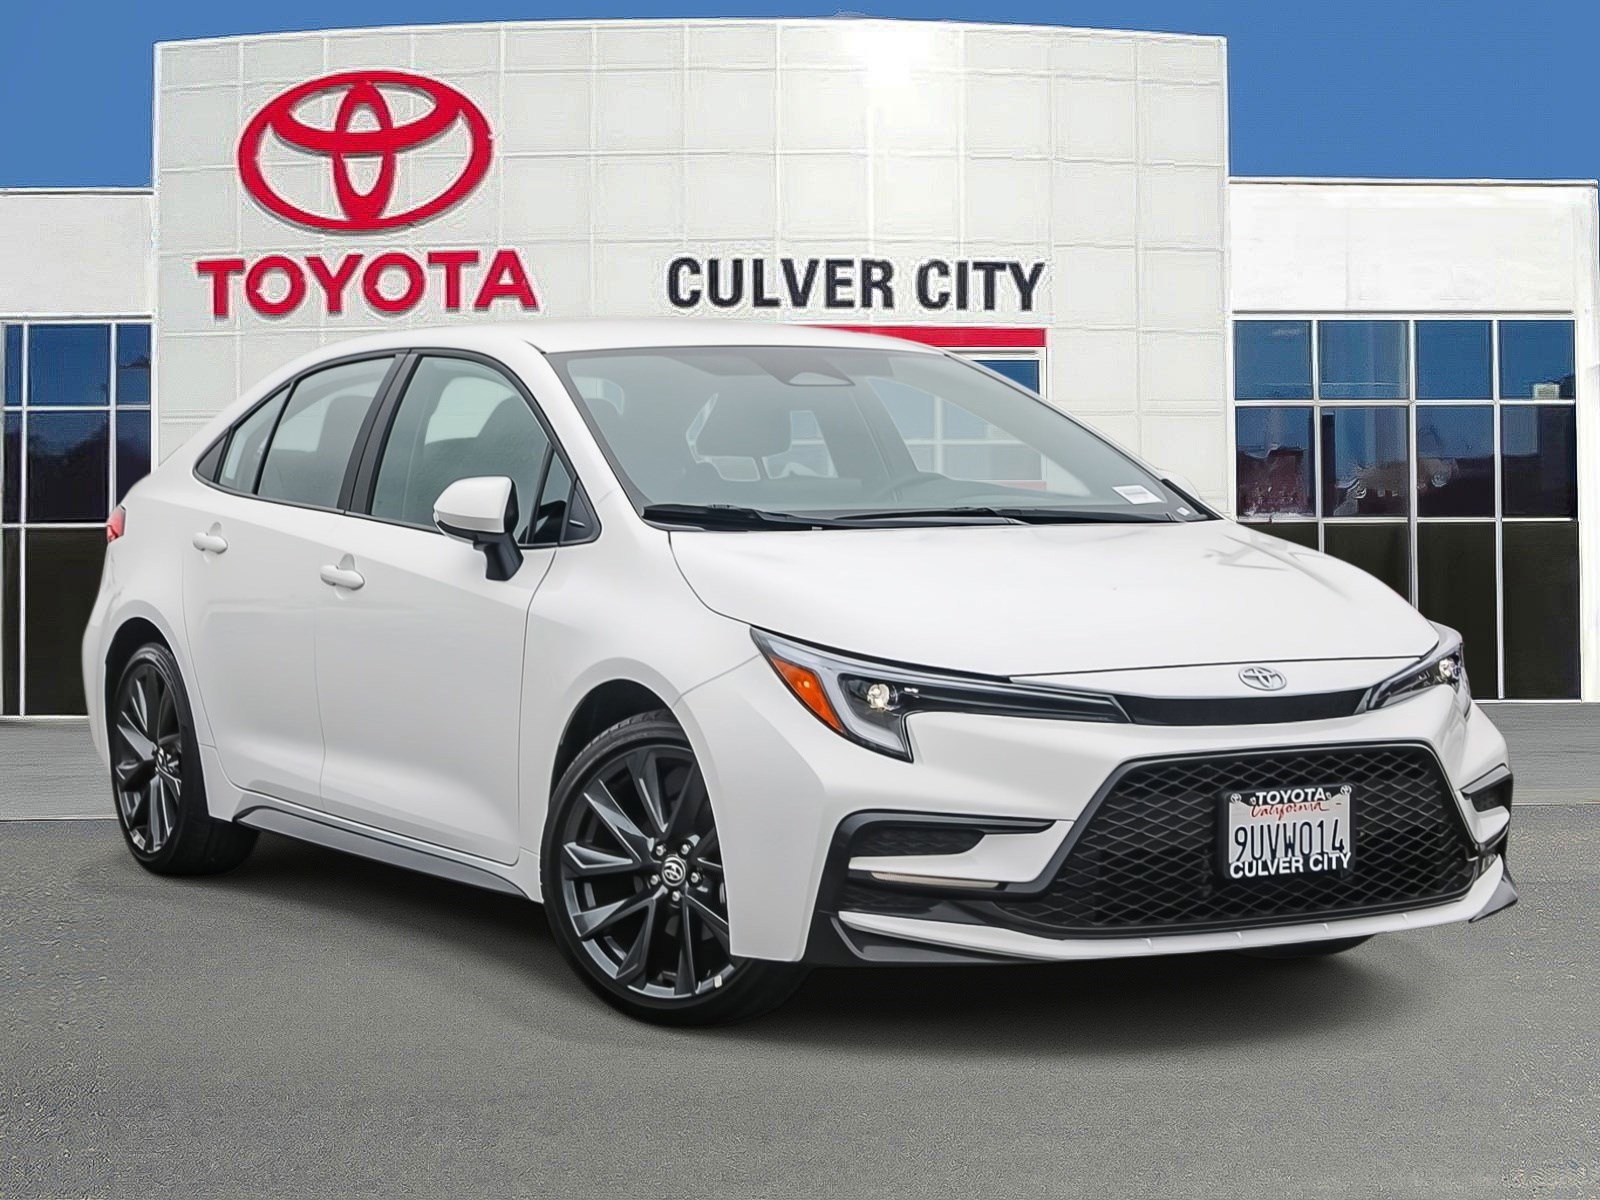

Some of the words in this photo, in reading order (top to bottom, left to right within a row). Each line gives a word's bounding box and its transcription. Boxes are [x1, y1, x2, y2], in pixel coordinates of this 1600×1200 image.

[196, 249, 538, 318] TOYOTA
[667, 257, 895, 309] CULVER
[916, 259, 1046, 311] CITY
[1251, 802, 1329, 821] California
[1256, 787, 1326, 806] TOYOTA
[1234, 819, 1345, 861] 9UVW014
[1230, 855, 1303, 879] CULVER
[1309, 852, 1351, 872] CITY
